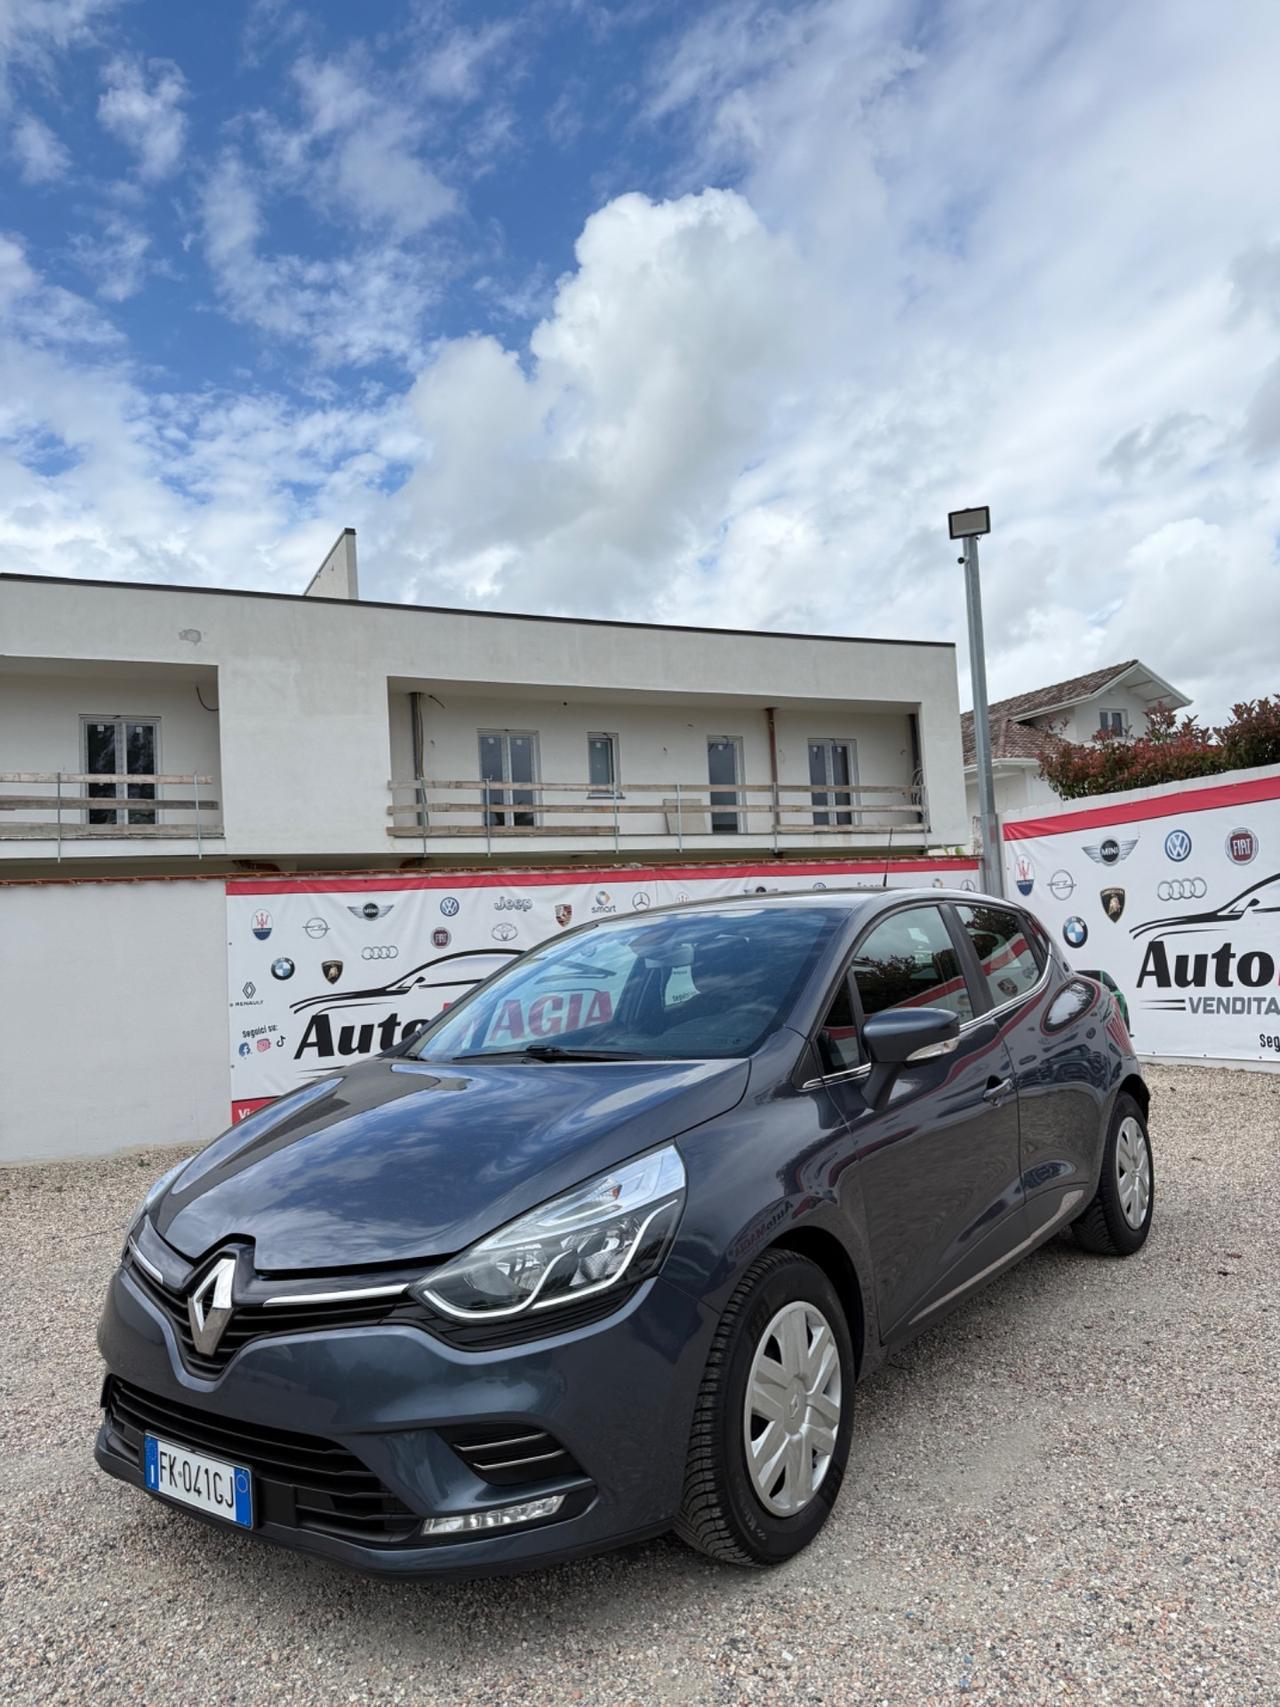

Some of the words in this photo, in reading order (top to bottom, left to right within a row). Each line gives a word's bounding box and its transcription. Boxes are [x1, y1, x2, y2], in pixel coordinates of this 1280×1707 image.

[1101, 847, 1120, 856] MINI
[1232, 838, 1251, 856] FIAT
[494, 897, 533, 912] Jeep
[591, 904, 617, 914] smart
[242, 1025, 267, 1038] Seguici
[268, 1024, 279, 1033] su:
